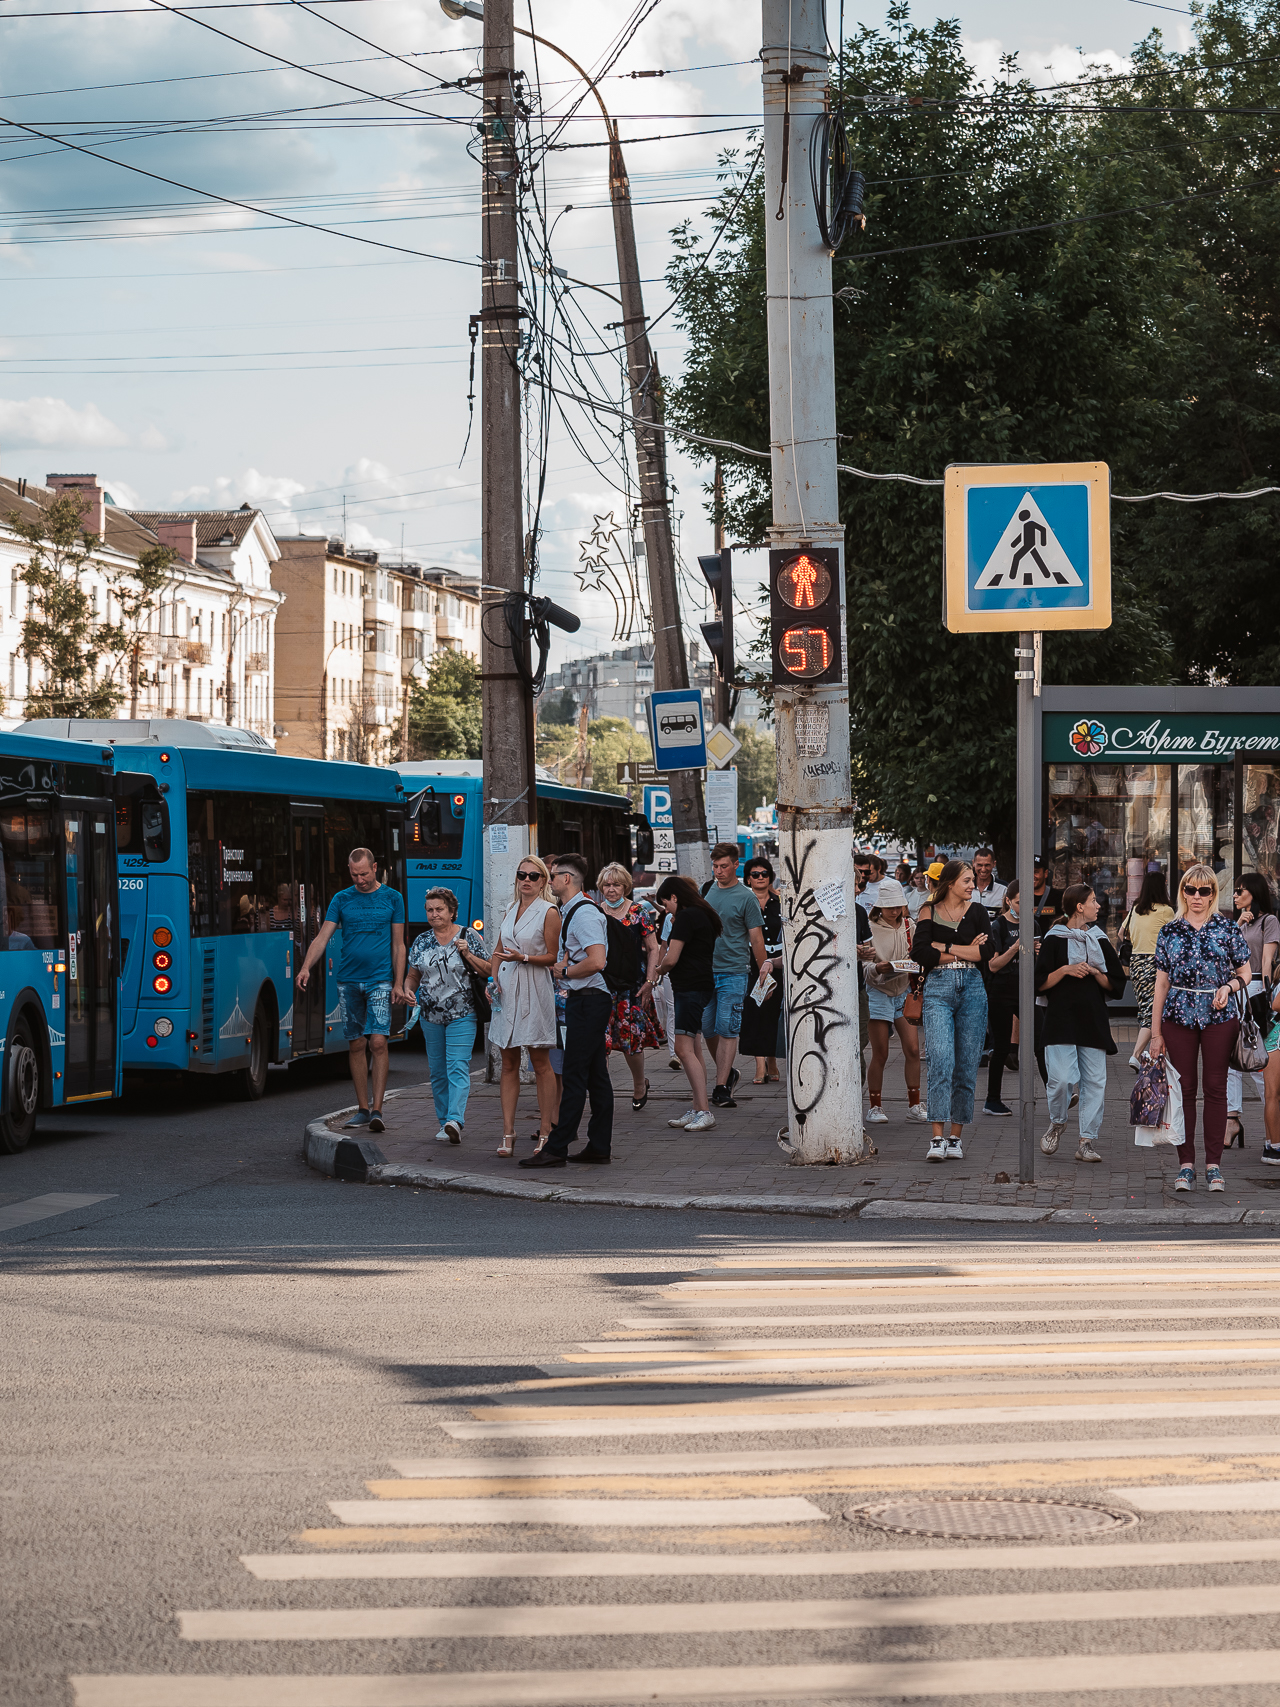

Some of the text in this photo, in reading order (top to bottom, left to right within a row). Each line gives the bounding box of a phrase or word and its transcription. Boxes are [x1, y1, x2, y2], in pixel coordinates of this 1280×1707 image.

[785, 629, 828, 671] 57
[1111, 719, 1196, 754] Арт
[1200, 730, 1280, 755] Букет
[123, 858, 150, 868] 4292
[441, 863, 462, 871] 5292
